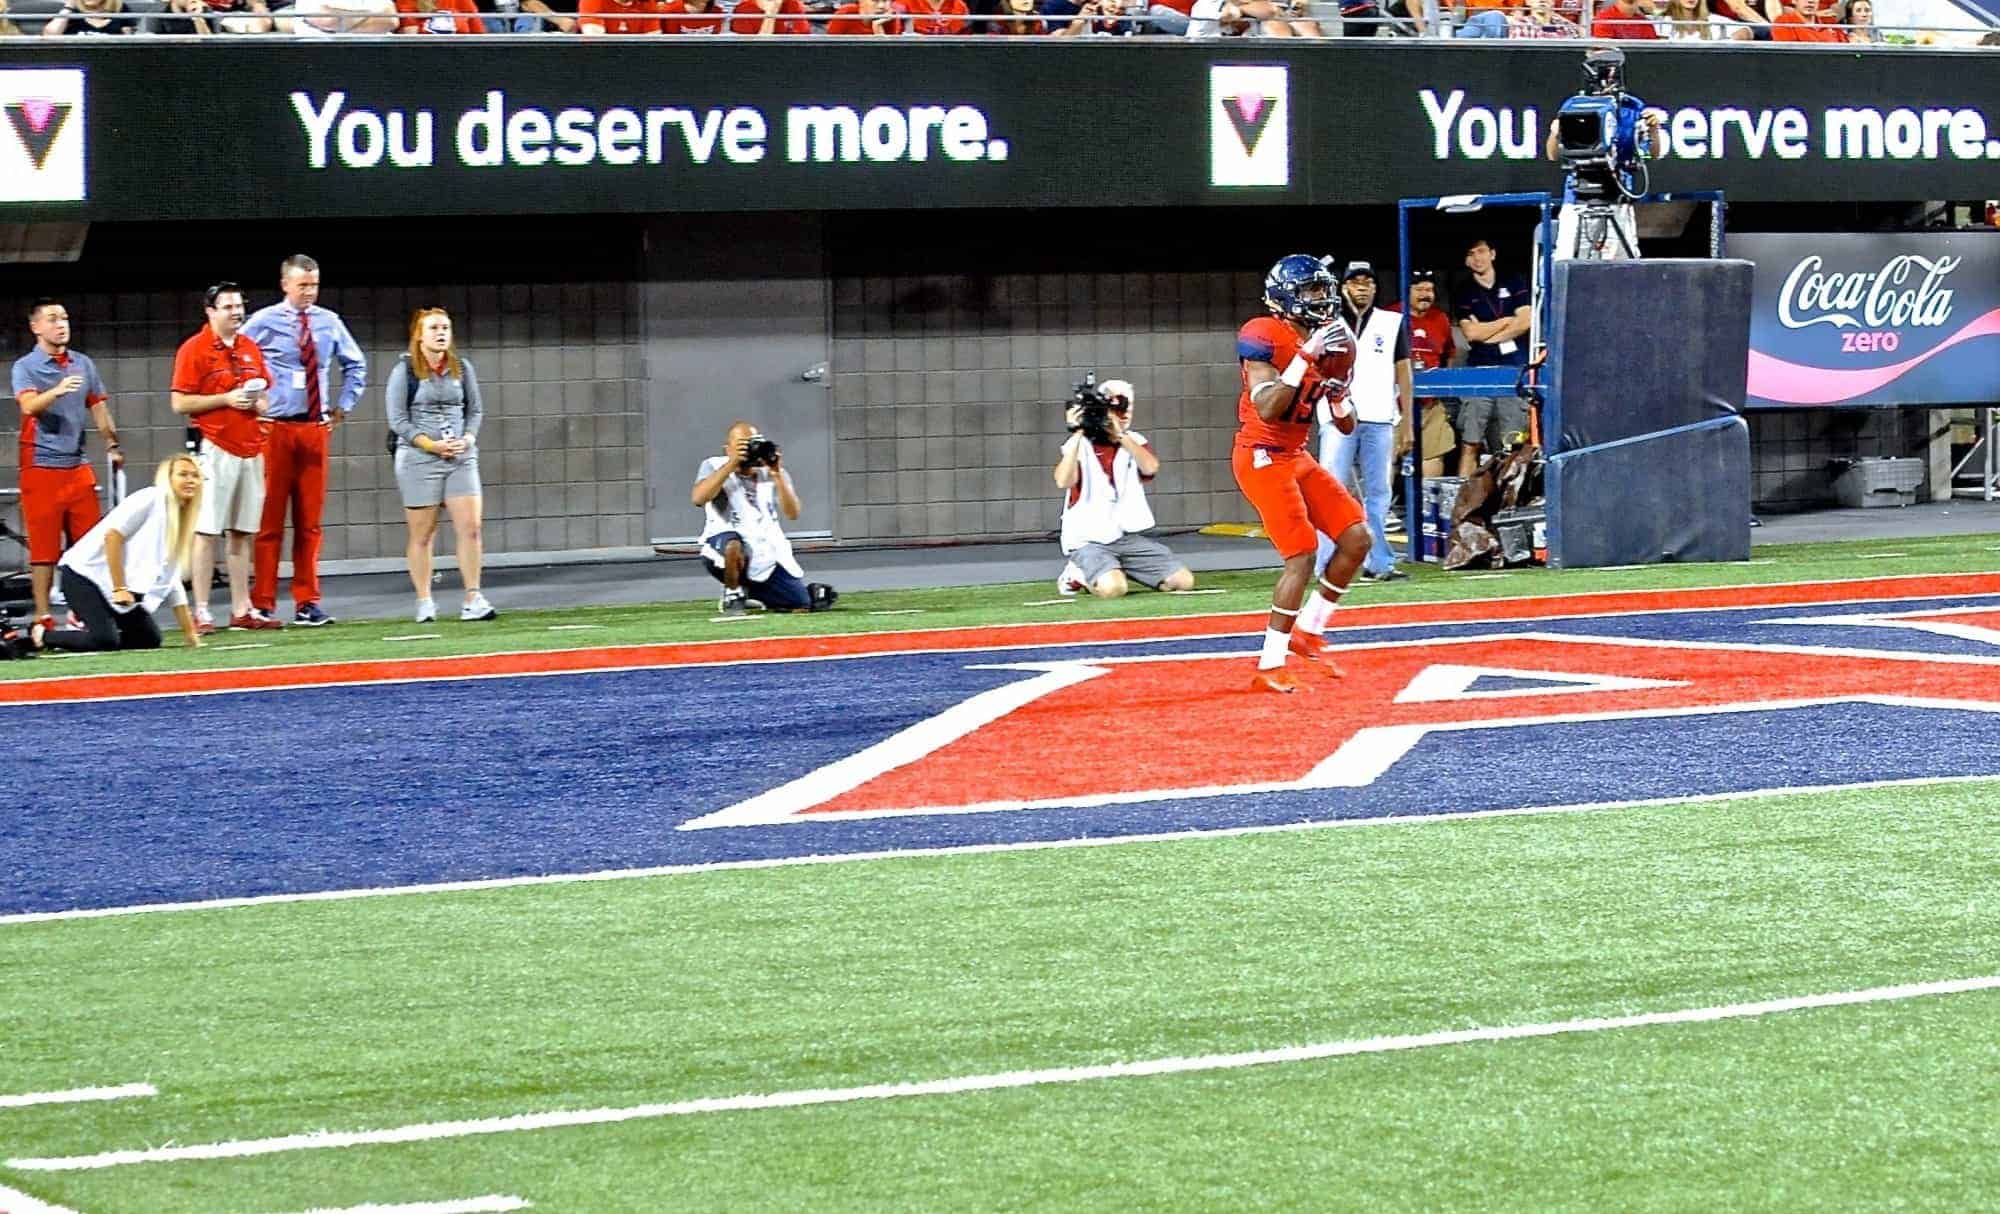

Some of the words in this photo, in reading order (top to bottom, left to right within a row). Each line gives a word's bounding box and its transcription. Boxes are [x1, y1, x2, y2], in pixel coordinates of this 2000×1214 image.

[291, 92, 432, 167] You
[456, 91, 766, 166] deserve
[788, 106, 1007, 162] more.
[1420, 90, 1536, 159] You
[1638, 105, 1809, 161] serve
[1777, 254, 1962, 329] Coca-Cola
[1841, 332, 1899, 352] zero
[678, 606, 2000, 832] A
